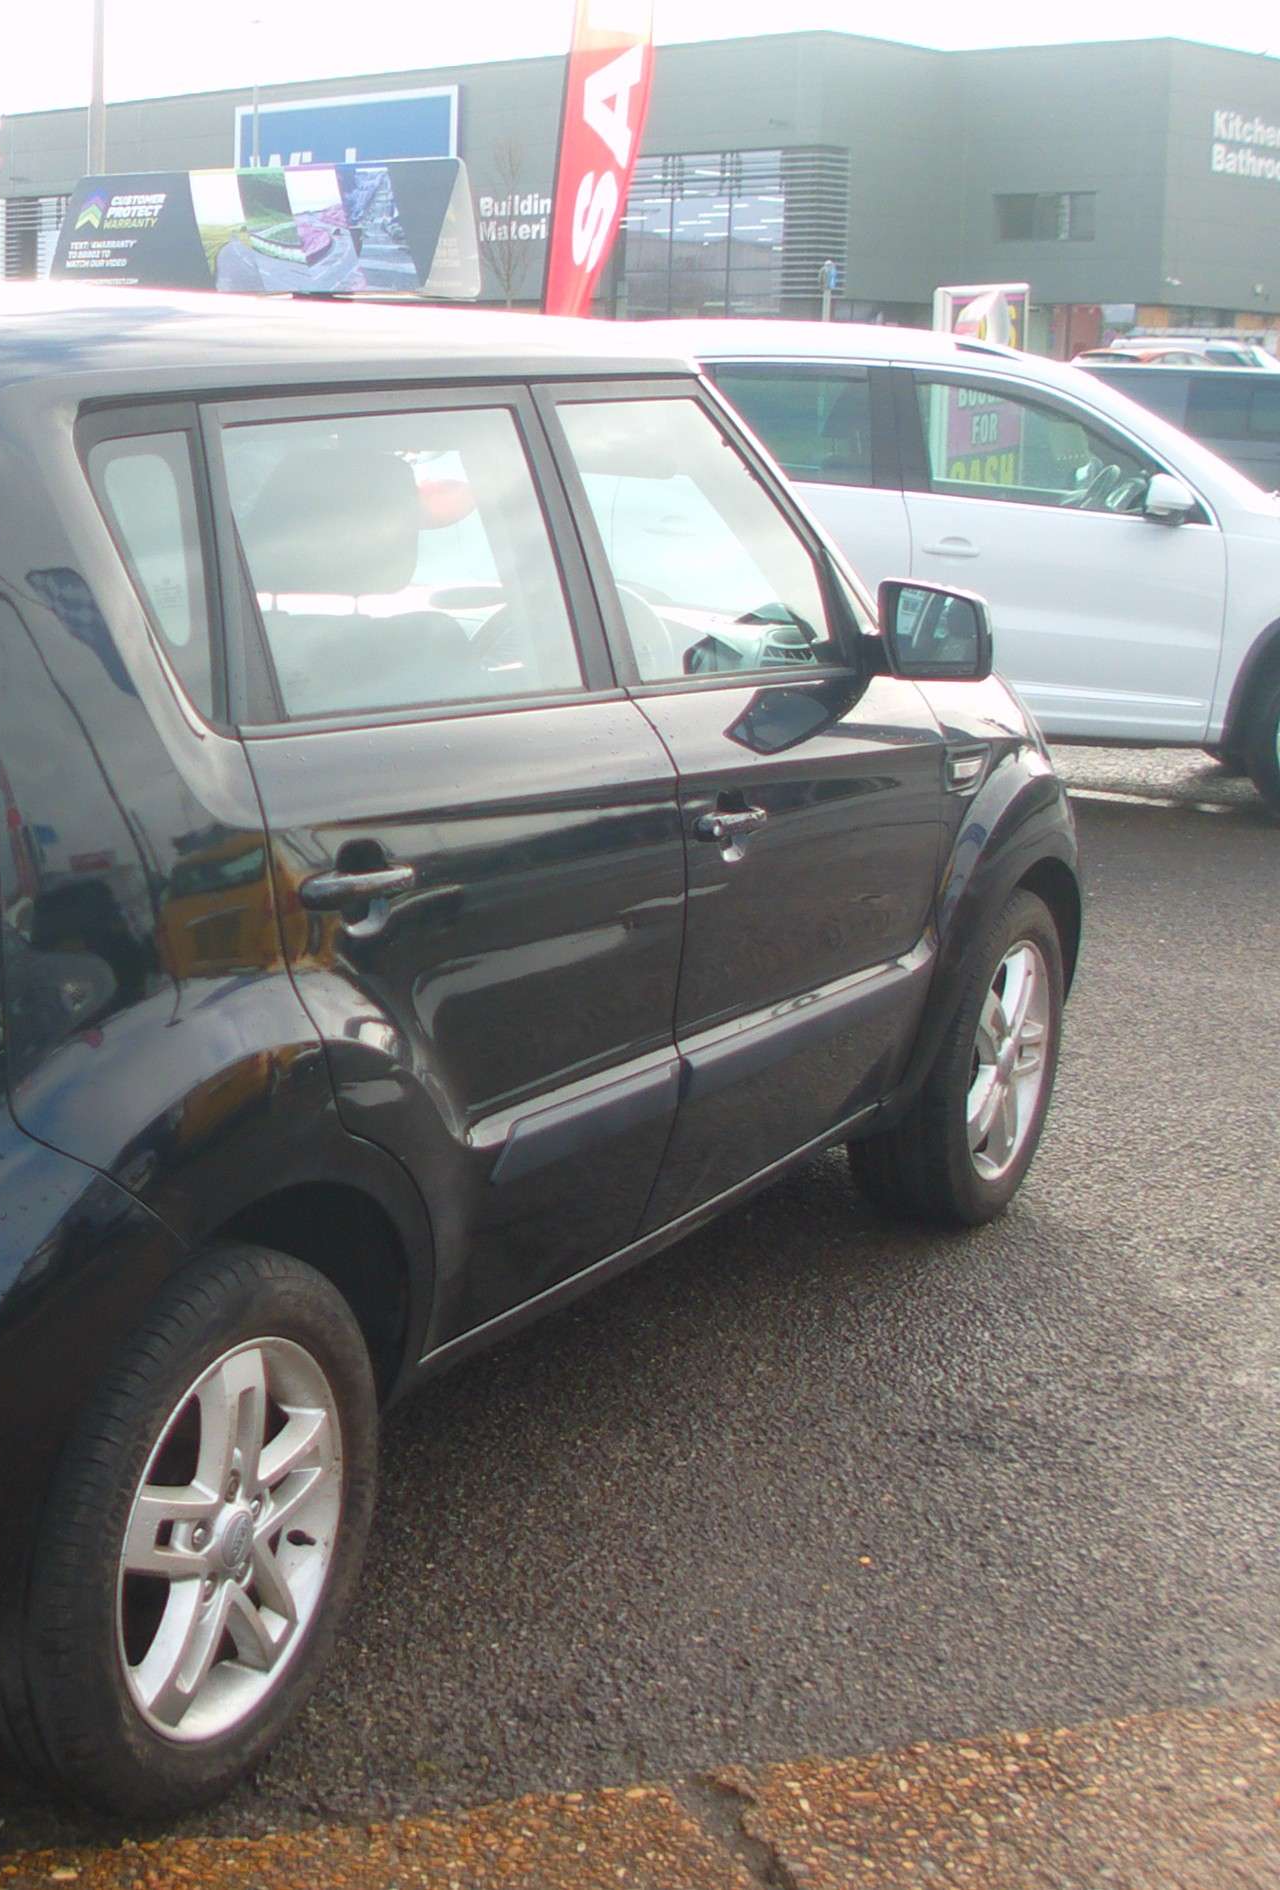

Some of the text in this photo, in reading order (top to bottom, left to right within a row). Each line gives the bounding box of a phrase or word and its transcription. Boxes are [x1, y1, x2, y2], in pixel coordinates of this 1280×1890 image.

[1213, 110, 1280, 148] Kitche
[106, 204, 163, 218] PROTECT
[479, 196, 551, 217] Buildin
[103, 217, 158, 230] WARRANTY
[479, 218, 547, 241] Materi
[971, 413, 998, 444] FOR
